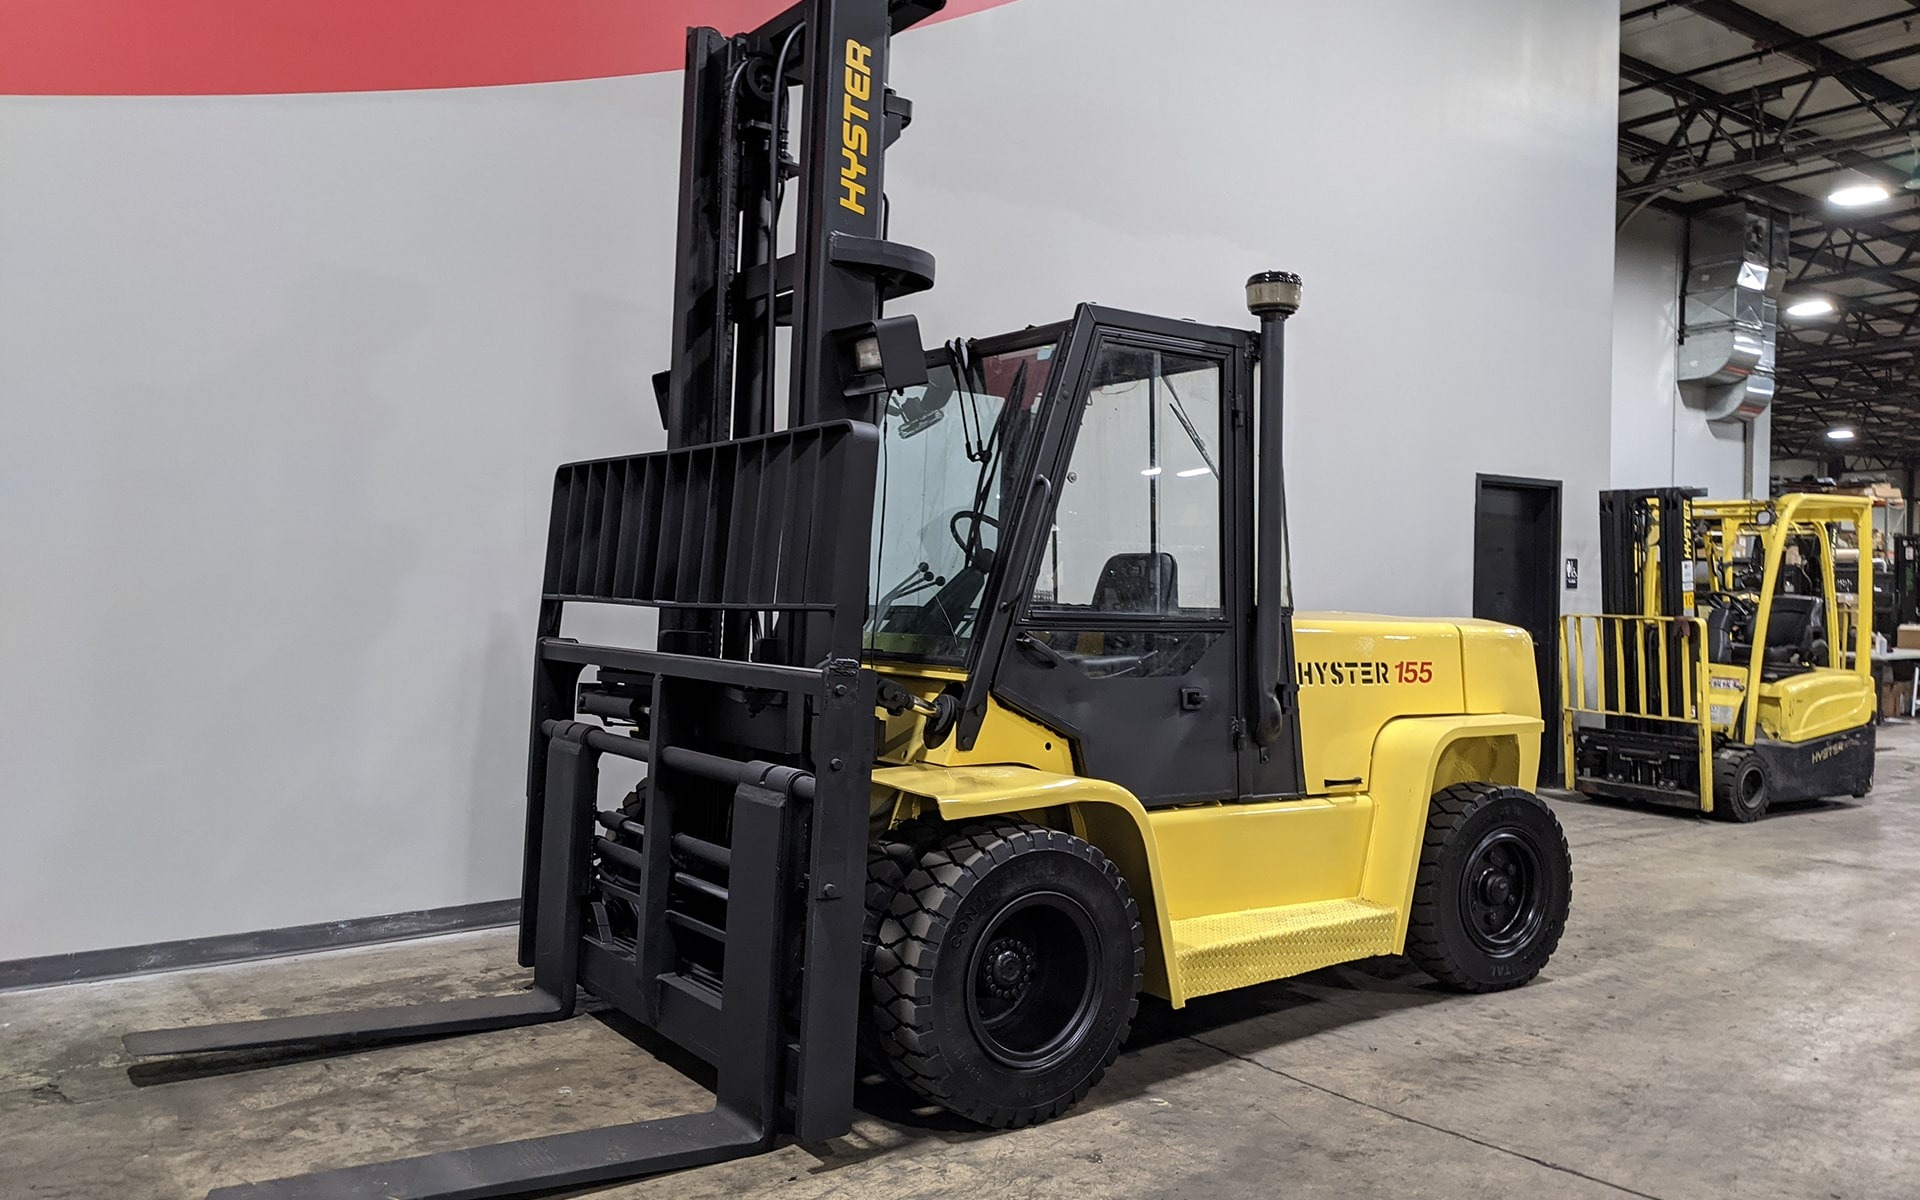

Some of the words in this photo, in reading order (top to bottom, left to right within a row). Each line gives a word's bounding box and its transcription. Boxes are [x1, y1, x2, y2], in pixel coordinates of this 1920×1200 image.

[840, 38, 872, 216] HYSTER
[1683, 500, 1692, 559] HYSTER
[1298, 661, 1390, 685] HYSTER
[1395, 661, 1433, 684] 155
